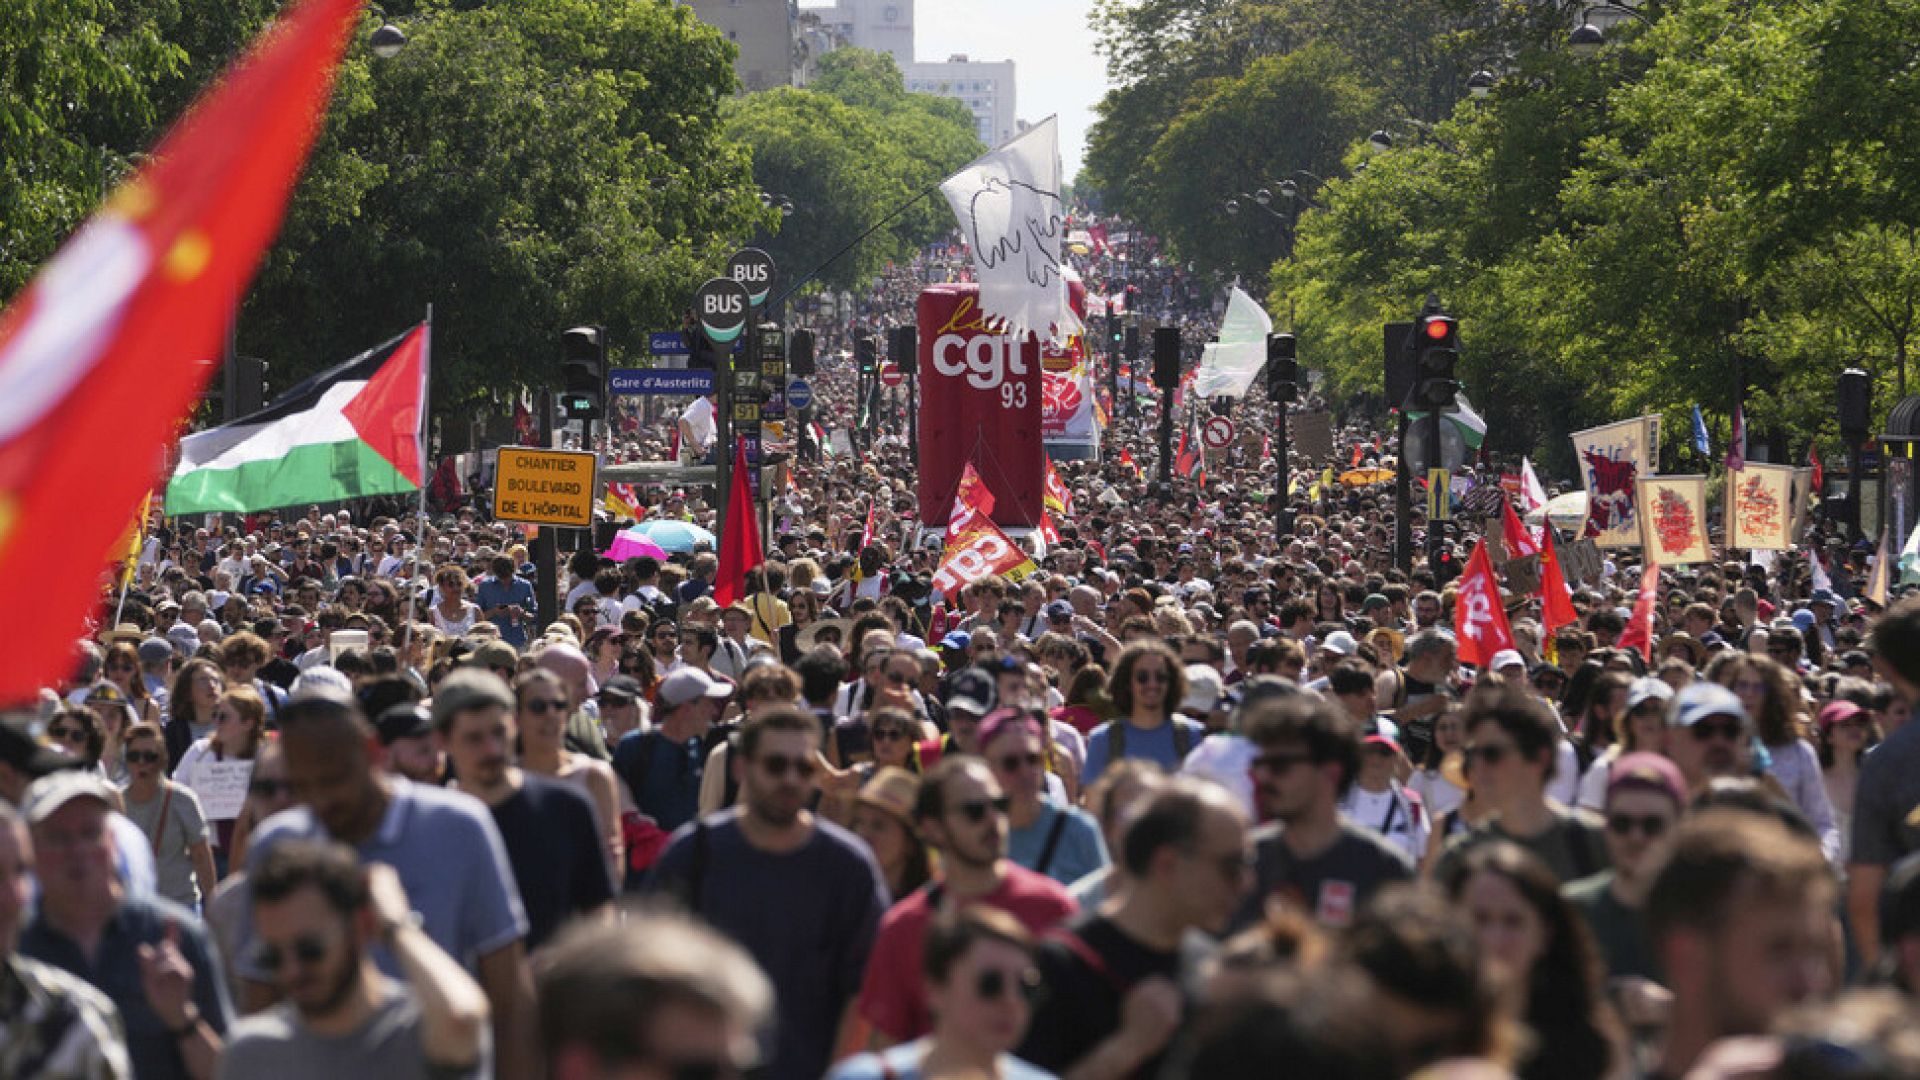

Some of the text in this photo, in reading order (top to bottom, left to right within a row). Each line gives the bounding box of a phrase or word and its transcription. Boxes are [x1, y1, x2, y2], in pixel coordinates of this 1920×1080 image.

[734, 264, 768, 281] BUS
[704, 294, 742, 313] BUS
[652, 340, 677, 348] Gare
[764, 334, 781, 346] 57
[764, 362, 782, 374] 91
[933, 334, 1027, 389] cgt
[612, 377, 711, 389] Gare d'Austerlitz
[737, 373, 756, 385] 57
[1001, 381, 1027, 409] 93
[737, 404, 756, 418] 91
[516, 456, 576, 471] CHANTIER
[508, 478, 581, 495] BOULEVARD
[502, 500, 584, 519] DE L'HÔPITAL
